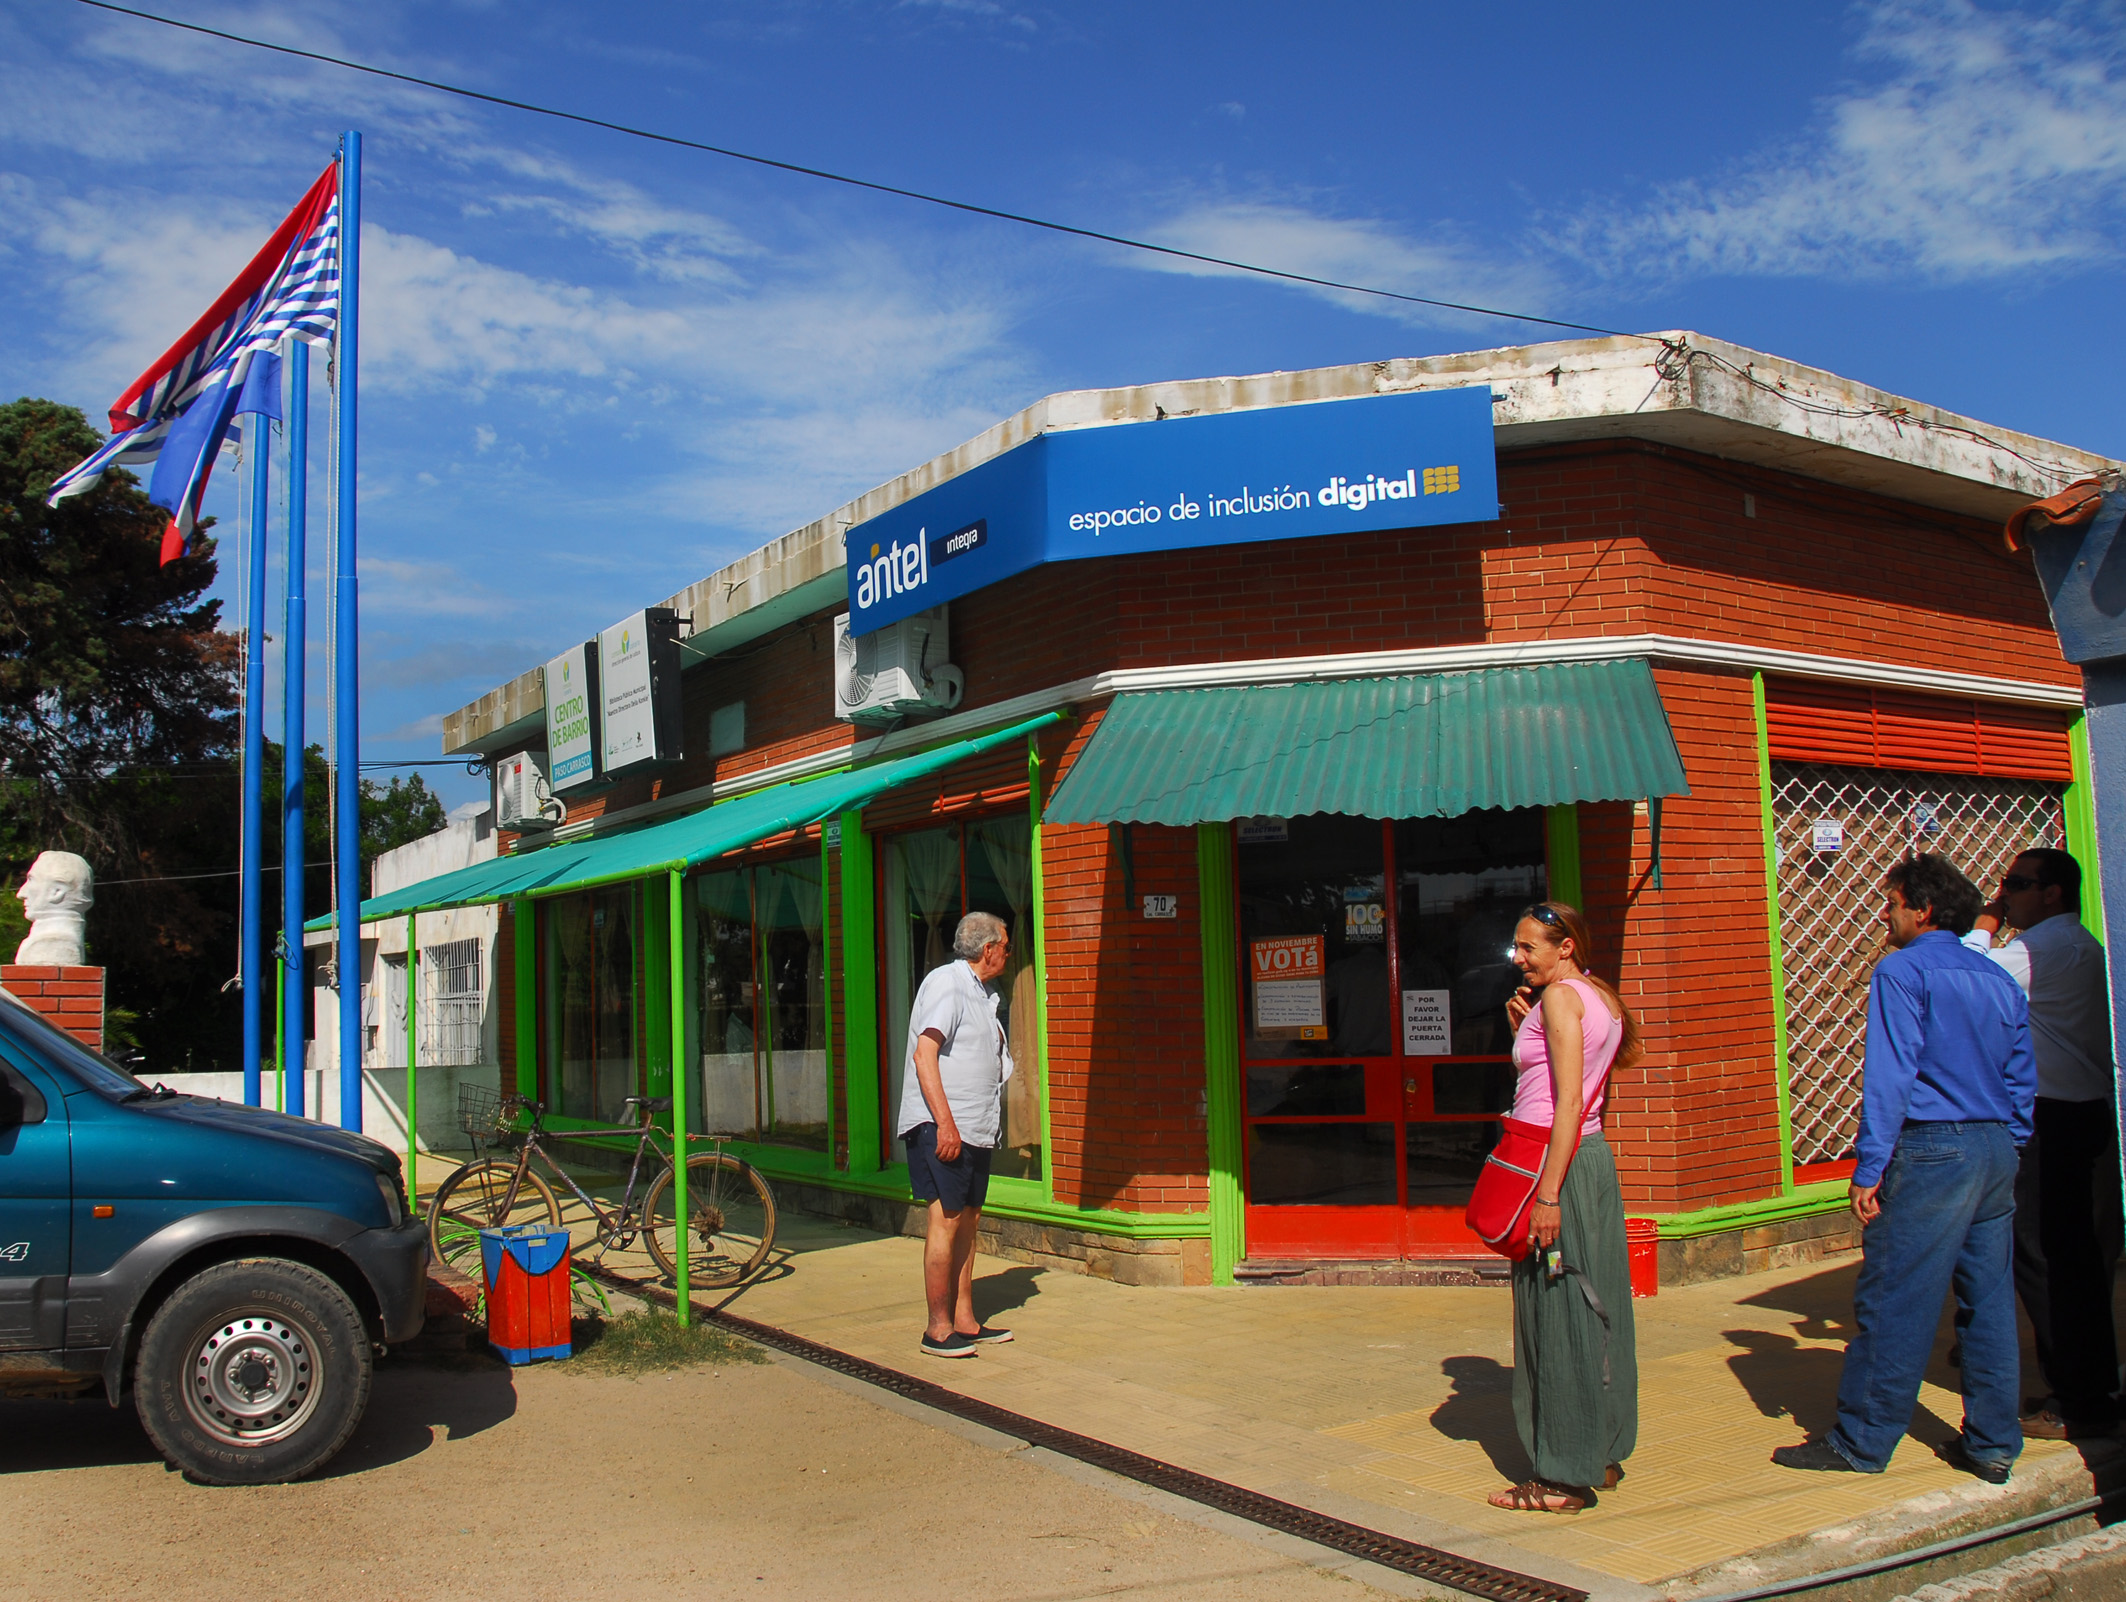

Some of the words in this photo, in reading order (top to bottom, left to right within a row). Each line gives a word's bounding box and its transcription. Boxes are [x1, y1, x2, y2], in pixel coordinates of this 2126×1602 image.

[1068, 499, 1160, 537] espacio
[1168, 492, 1201, 522] de
[1207, 484, 1311, 518] inclusión
[1317, 468, 1416, 512] digital
[946, 527, 979, 555] integra
[856, 527, 928, 611] antel
[554, 695, 584, 724] CENTRO
[552, 726, 561, 748] DE
[562, 716, 589, 744] BARRIO
[554, 765, 566, 779] PASO
[567, 754, 591, 775] CARRASCO
[1153, 897, 1166, 911] 70
[1345, 904, 1385, 925] 100%
[1346, 925, 1358, 935] SIN
[1360, 924, 1383, 935] HUMO
[1256, 943, 1267, 951] EN
[1268, 937, 1318, 949] NOVIEMBRE
[1256, 945, 1318, 971] VOTá
[0, 1242, 31, 1261] 4
[251, 1289, 336, 1360] UNIROYAL
[181, 1429, 265, 1464] LAREDO
